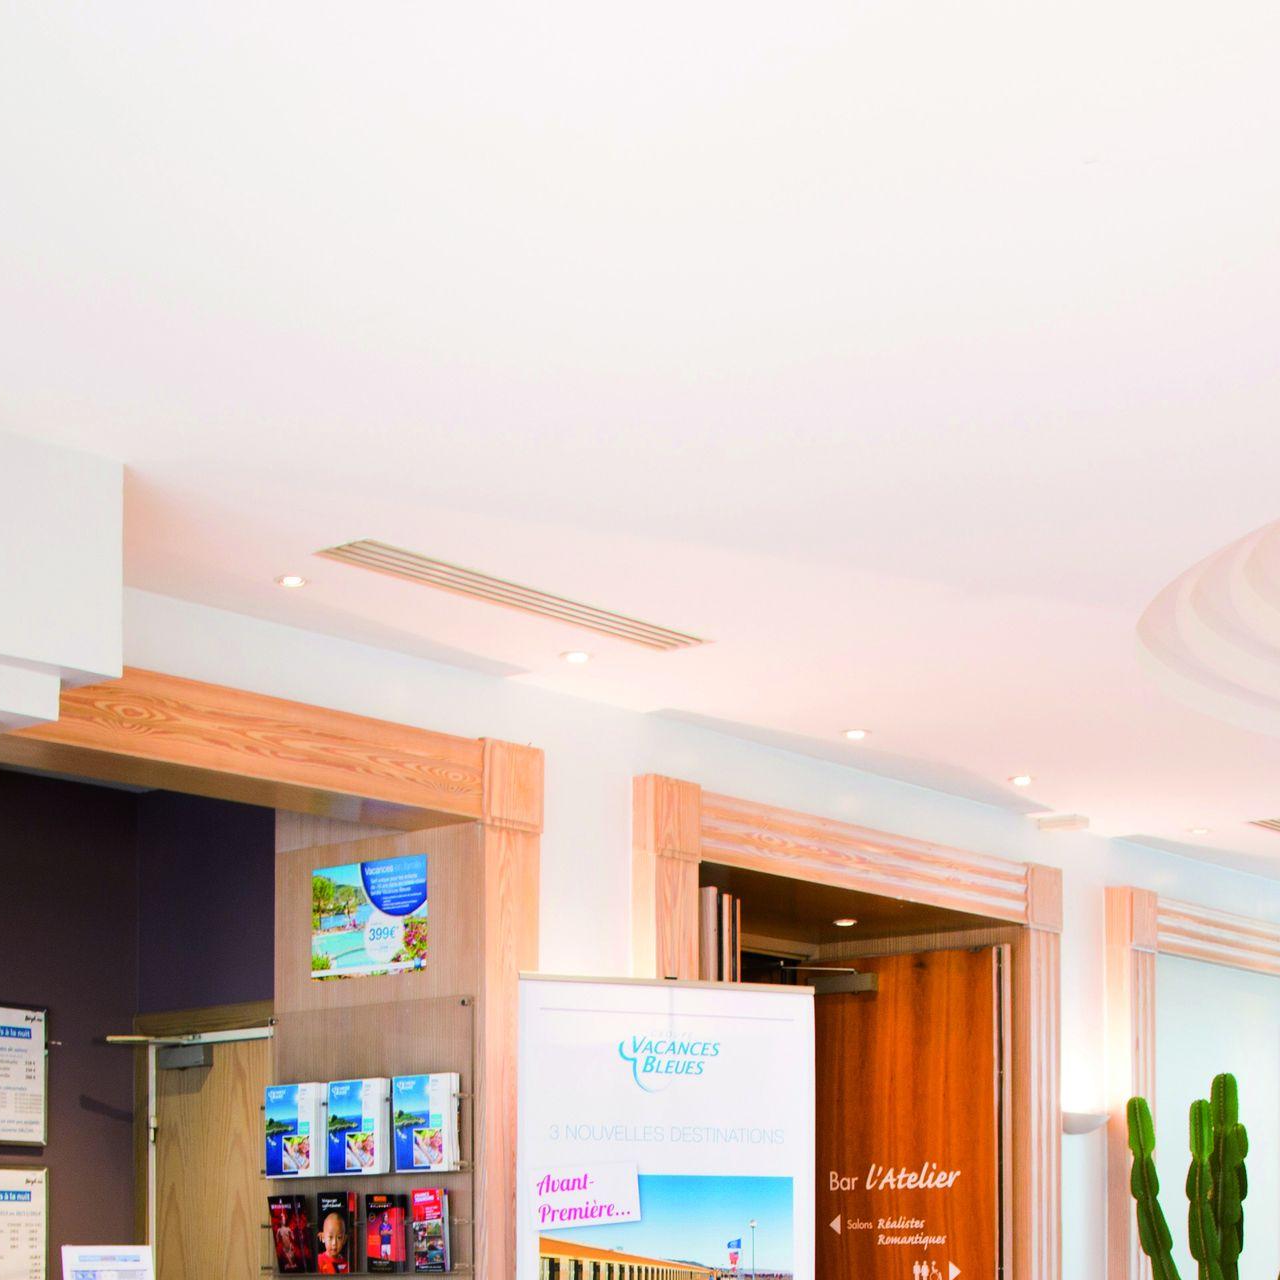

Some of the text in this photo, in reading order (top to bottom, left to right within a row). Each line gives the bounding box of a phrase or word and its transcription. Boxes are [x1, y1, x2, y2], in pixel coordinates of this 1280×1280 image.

[17, 1029, 31, 1038] nuit
[631, 1035, 720, 1057] VACANCES
[642, 1055, 705, 1075] BLEUES
[549, 1124, 786, 1145] 3 NOUVELLES DESTINATIONS
[536, 1172, 595, 1196] Avant-
[829, 1161, 962, 1192] Bar l'Atelier
[17, 1192, 31, 1201] nuit
[846, 1216, 926, 1230] Salons Réalistes
[877, 1232, 948, 1251] Romantiques
